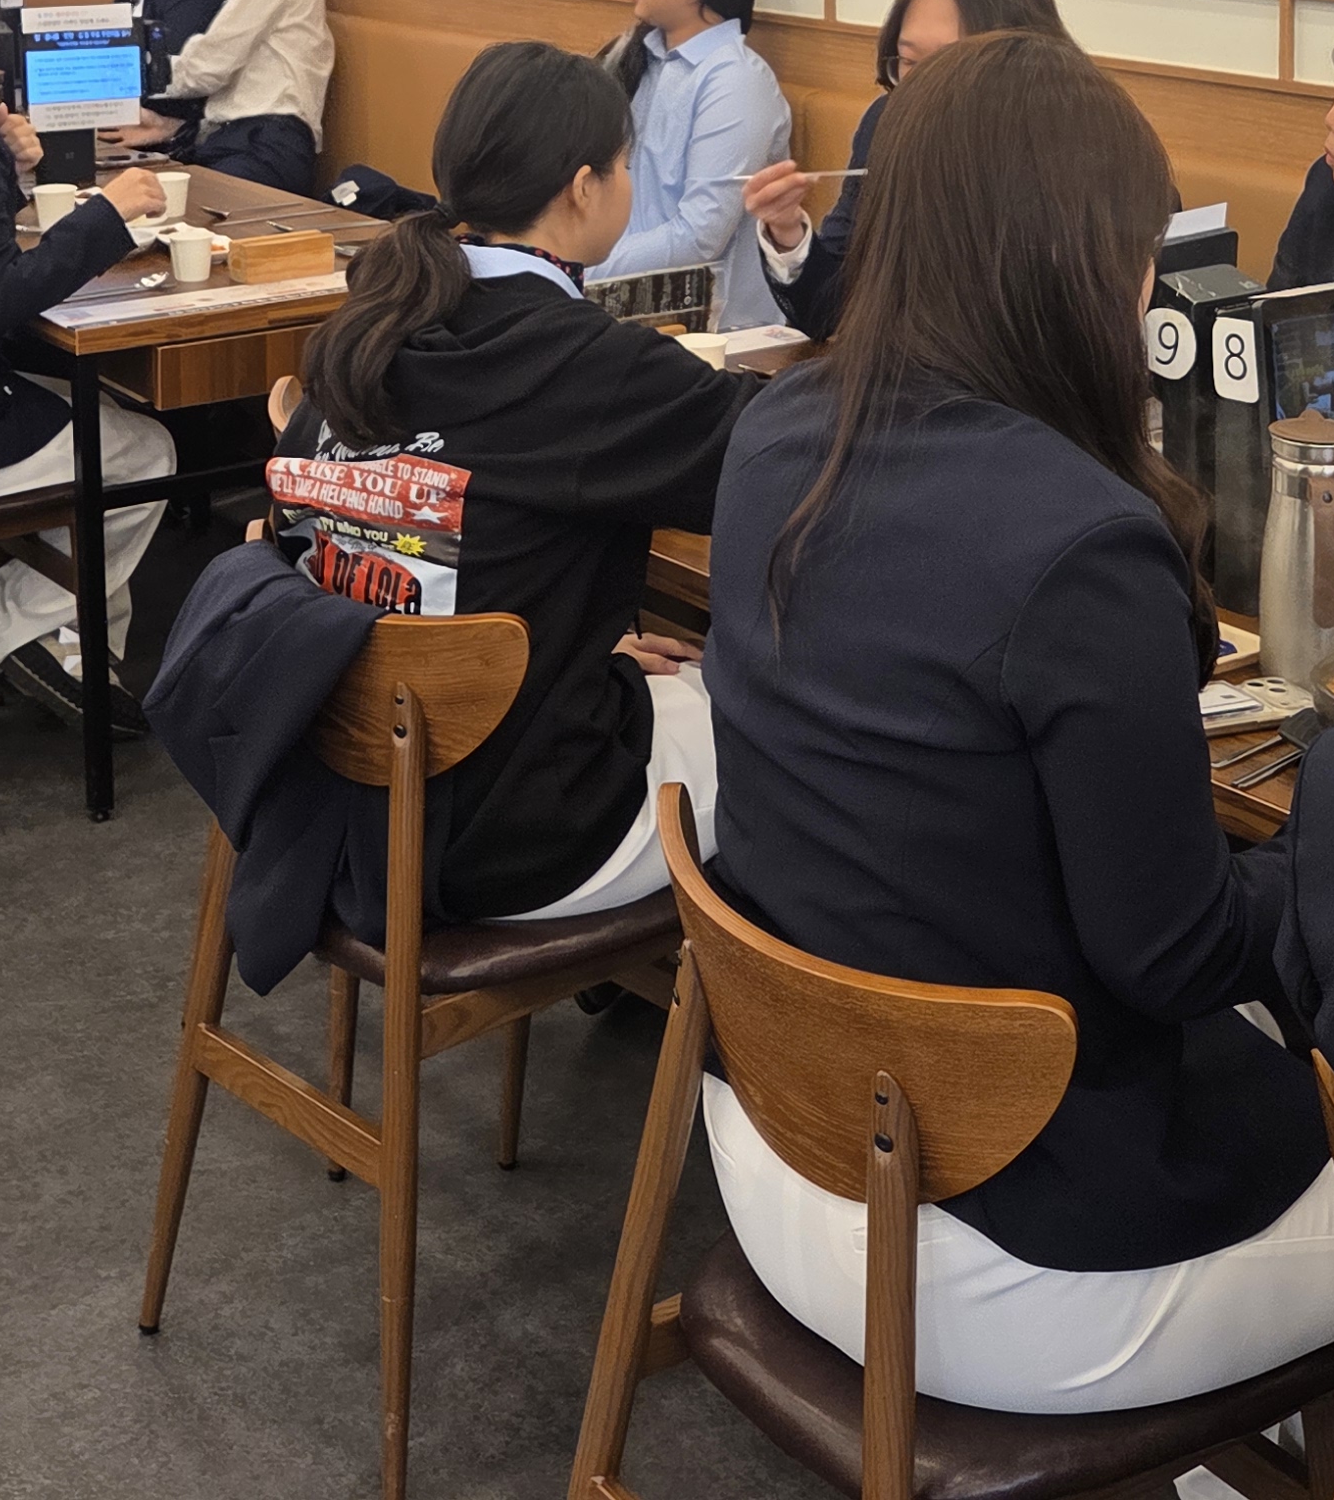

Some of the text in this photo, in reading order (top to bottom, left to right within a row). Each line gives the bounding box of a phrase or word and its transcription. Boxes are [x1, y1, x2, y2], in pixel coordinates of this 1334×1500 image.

[1155, 322, 1179, 365] 9
[1224, 333, 1248, 381] 8
[352, 468, 402, 497] YOU
[409, 482, 446, 505] UP
[398, 462, 412, 480] TO
[367, 493, 404, 519] HAND
[363, 528, 388, 542] YOU
